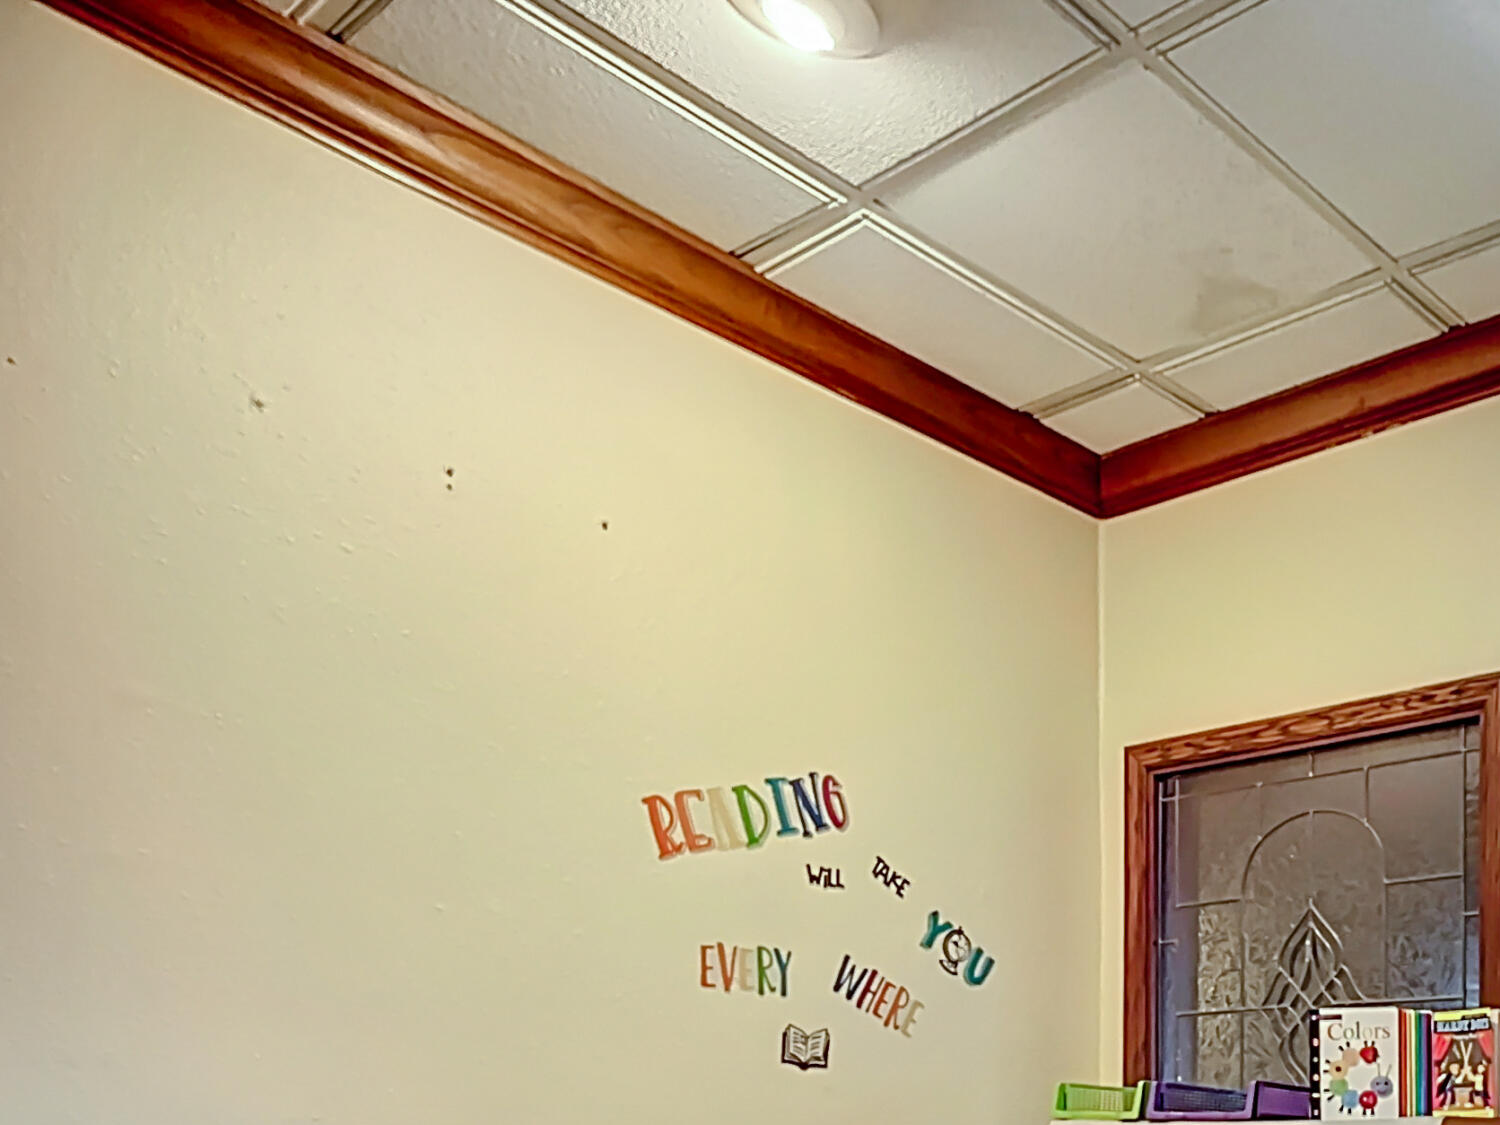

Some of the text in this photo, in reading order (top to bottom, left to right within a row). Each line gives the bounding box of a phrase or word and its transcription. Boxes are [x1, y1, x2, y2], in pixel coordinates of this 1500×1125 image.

[641, 771, 849, 861] READING
[871, 856, 911, 899] TAKE
[919, 910, 996, 987] YOU
[699, 941, 926, 1038] EVERY WHERE
[1327, 1021, 1391, 1041] Colors
